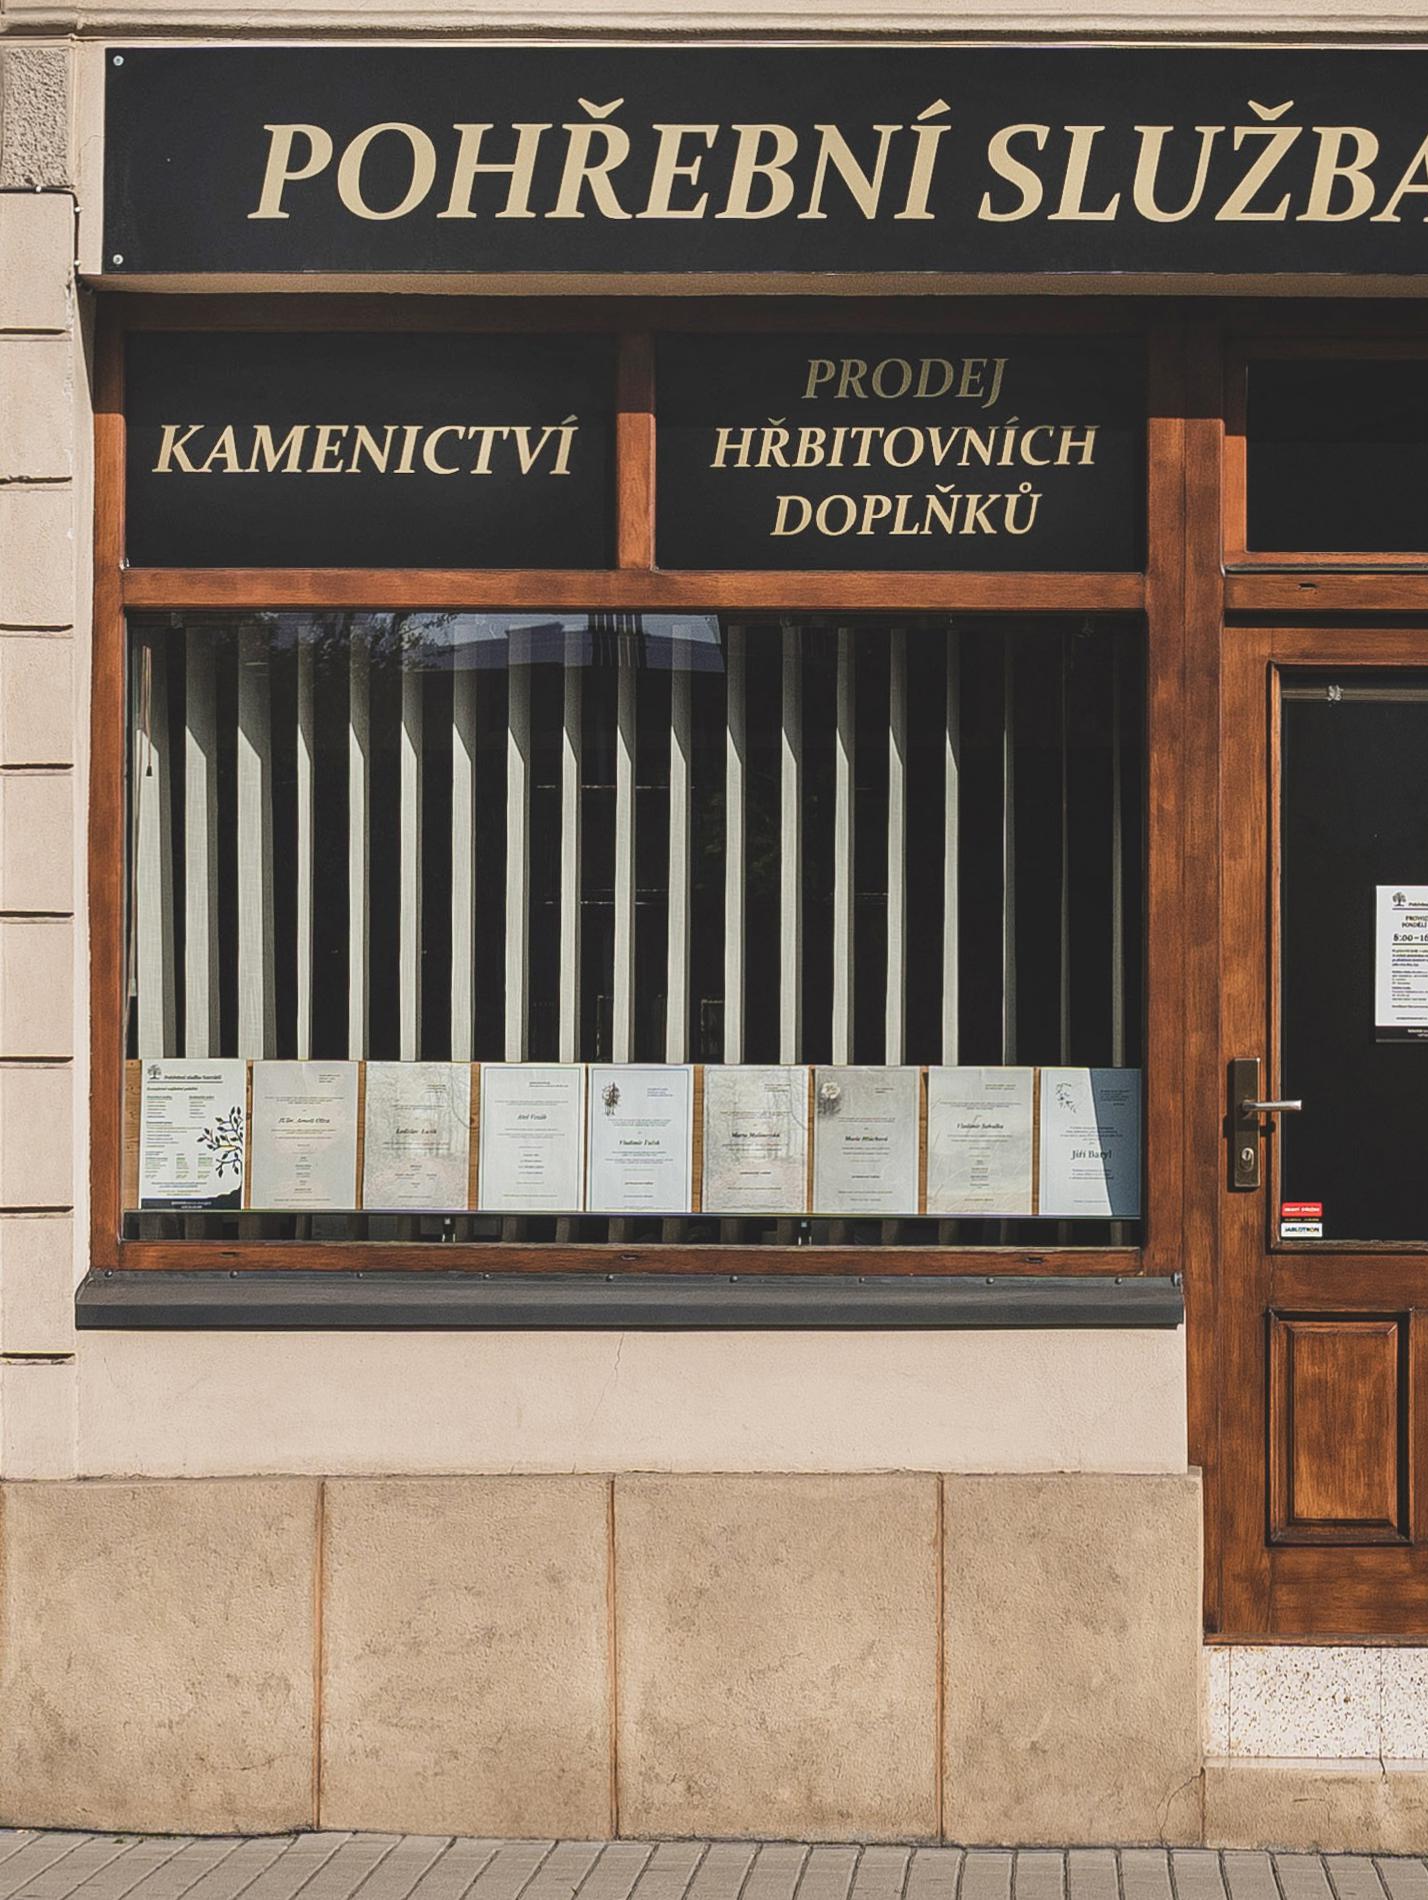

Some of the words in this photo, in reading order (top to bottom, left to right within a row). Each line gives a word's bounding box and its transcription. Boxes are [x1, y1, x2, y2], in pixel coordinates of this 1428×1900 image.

[246, 97, 952, 221] POHŘEBNÍ
[800, 358, 1009, 408] PRODEJ
[151, 414, 579, 475] KAMENICTVÍ
[709, 414, 1098, 468] HŘBITOVNÍCH
[769, 481, 1043, 537] DOPLŇKŮ
